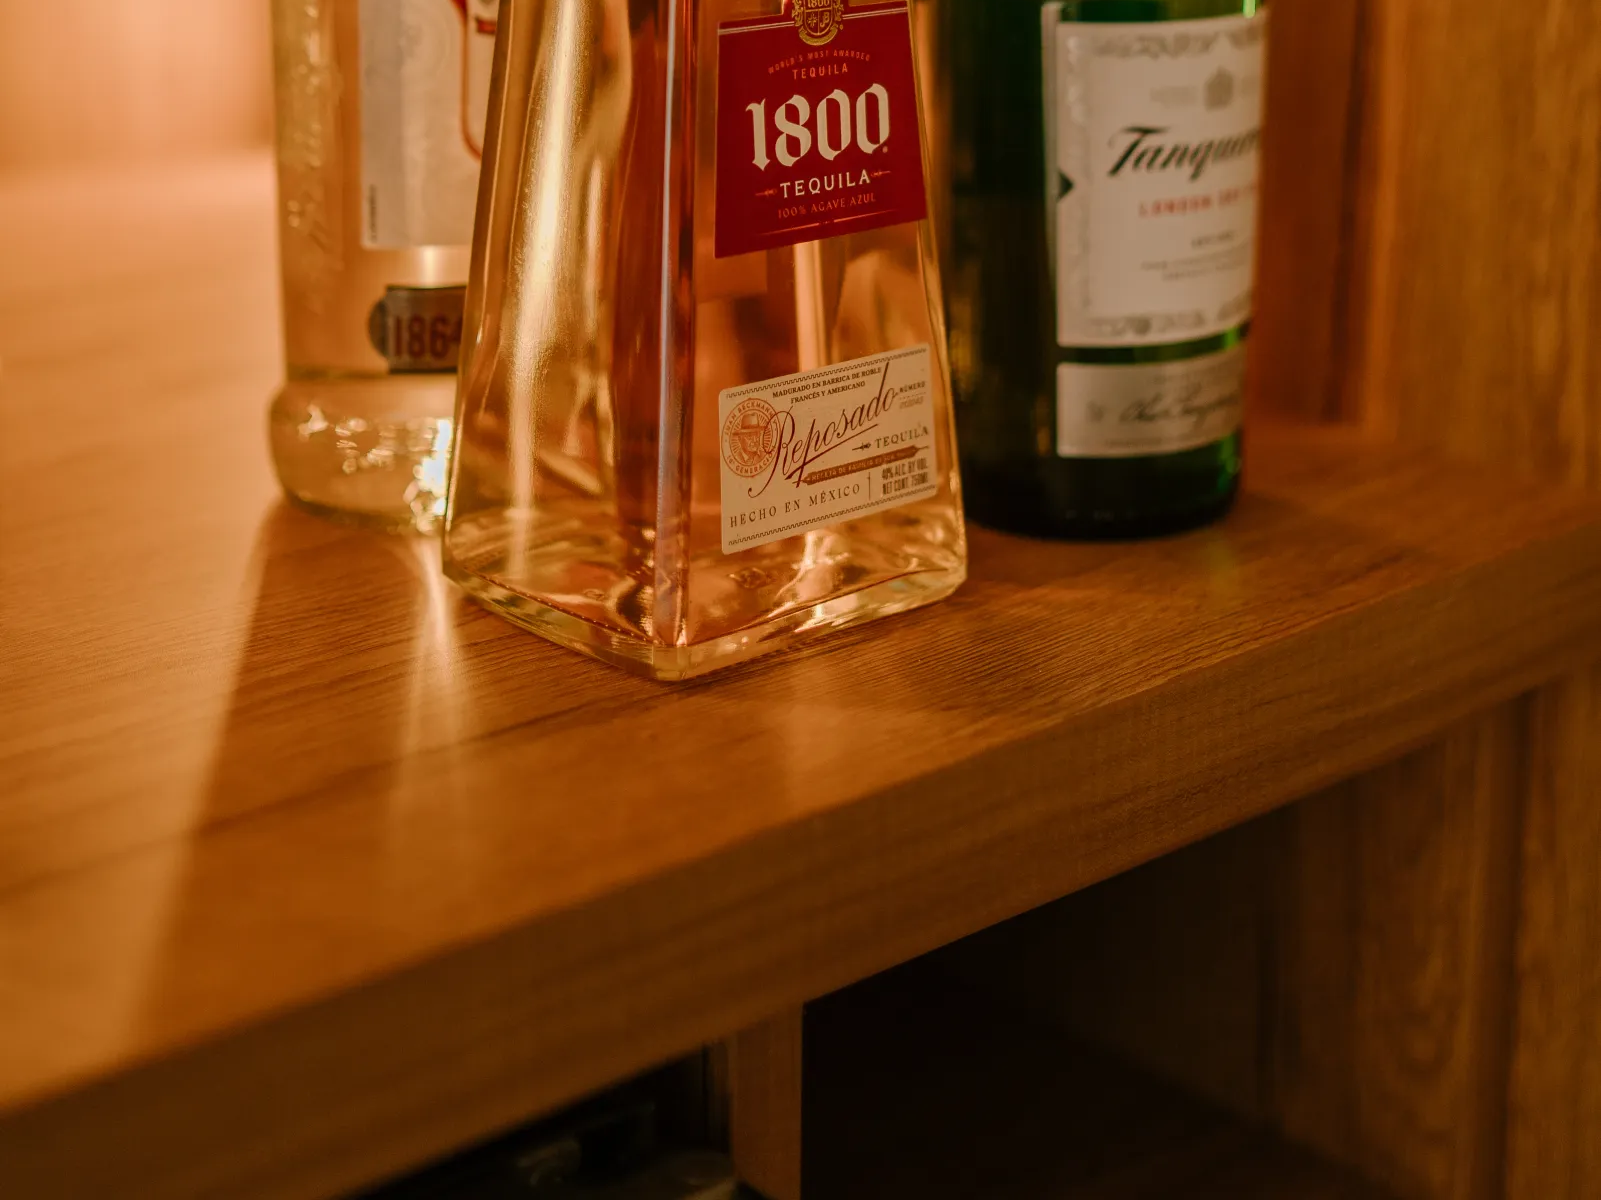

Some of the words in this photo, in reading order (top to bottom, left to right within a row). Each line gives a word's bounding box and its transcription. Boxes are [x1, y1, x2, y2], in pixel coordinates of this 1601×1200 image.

[768, 53, 803, 74] WORLD'S
[807, 50, 829, 60] MOST
[833, 49, 870, 61] AWARDED
[792, 63, 848, 80] TEQUILA
[745, 83, 890, 171] 1800
[780, 169, 871, 198] TEQUILA
[777, 205, 807, 219] 100%
[811, 197, 846, 213] AGAVE
[850, 192, 876, 206] AZUL
[772, 383, 811, 398] MADURADO
[812, 381, 821, 389] EN
[822, 375, 850, 387] BARRICA
[861, 367, 882, 377] ROBLE
[790, 391, 820, 404] FRANCÉS
[827, 381, 866, 396] AMERICANO
[748, 362, 898, 498] Reposado
[875, 425, 928, 448] TEQUILA
[882, 482, 891, 495] NET
[729, 505, 777, 528] HECHO
[784, 499, 801, 513] EN
[809, 483, 860, 508] MÉXICO
